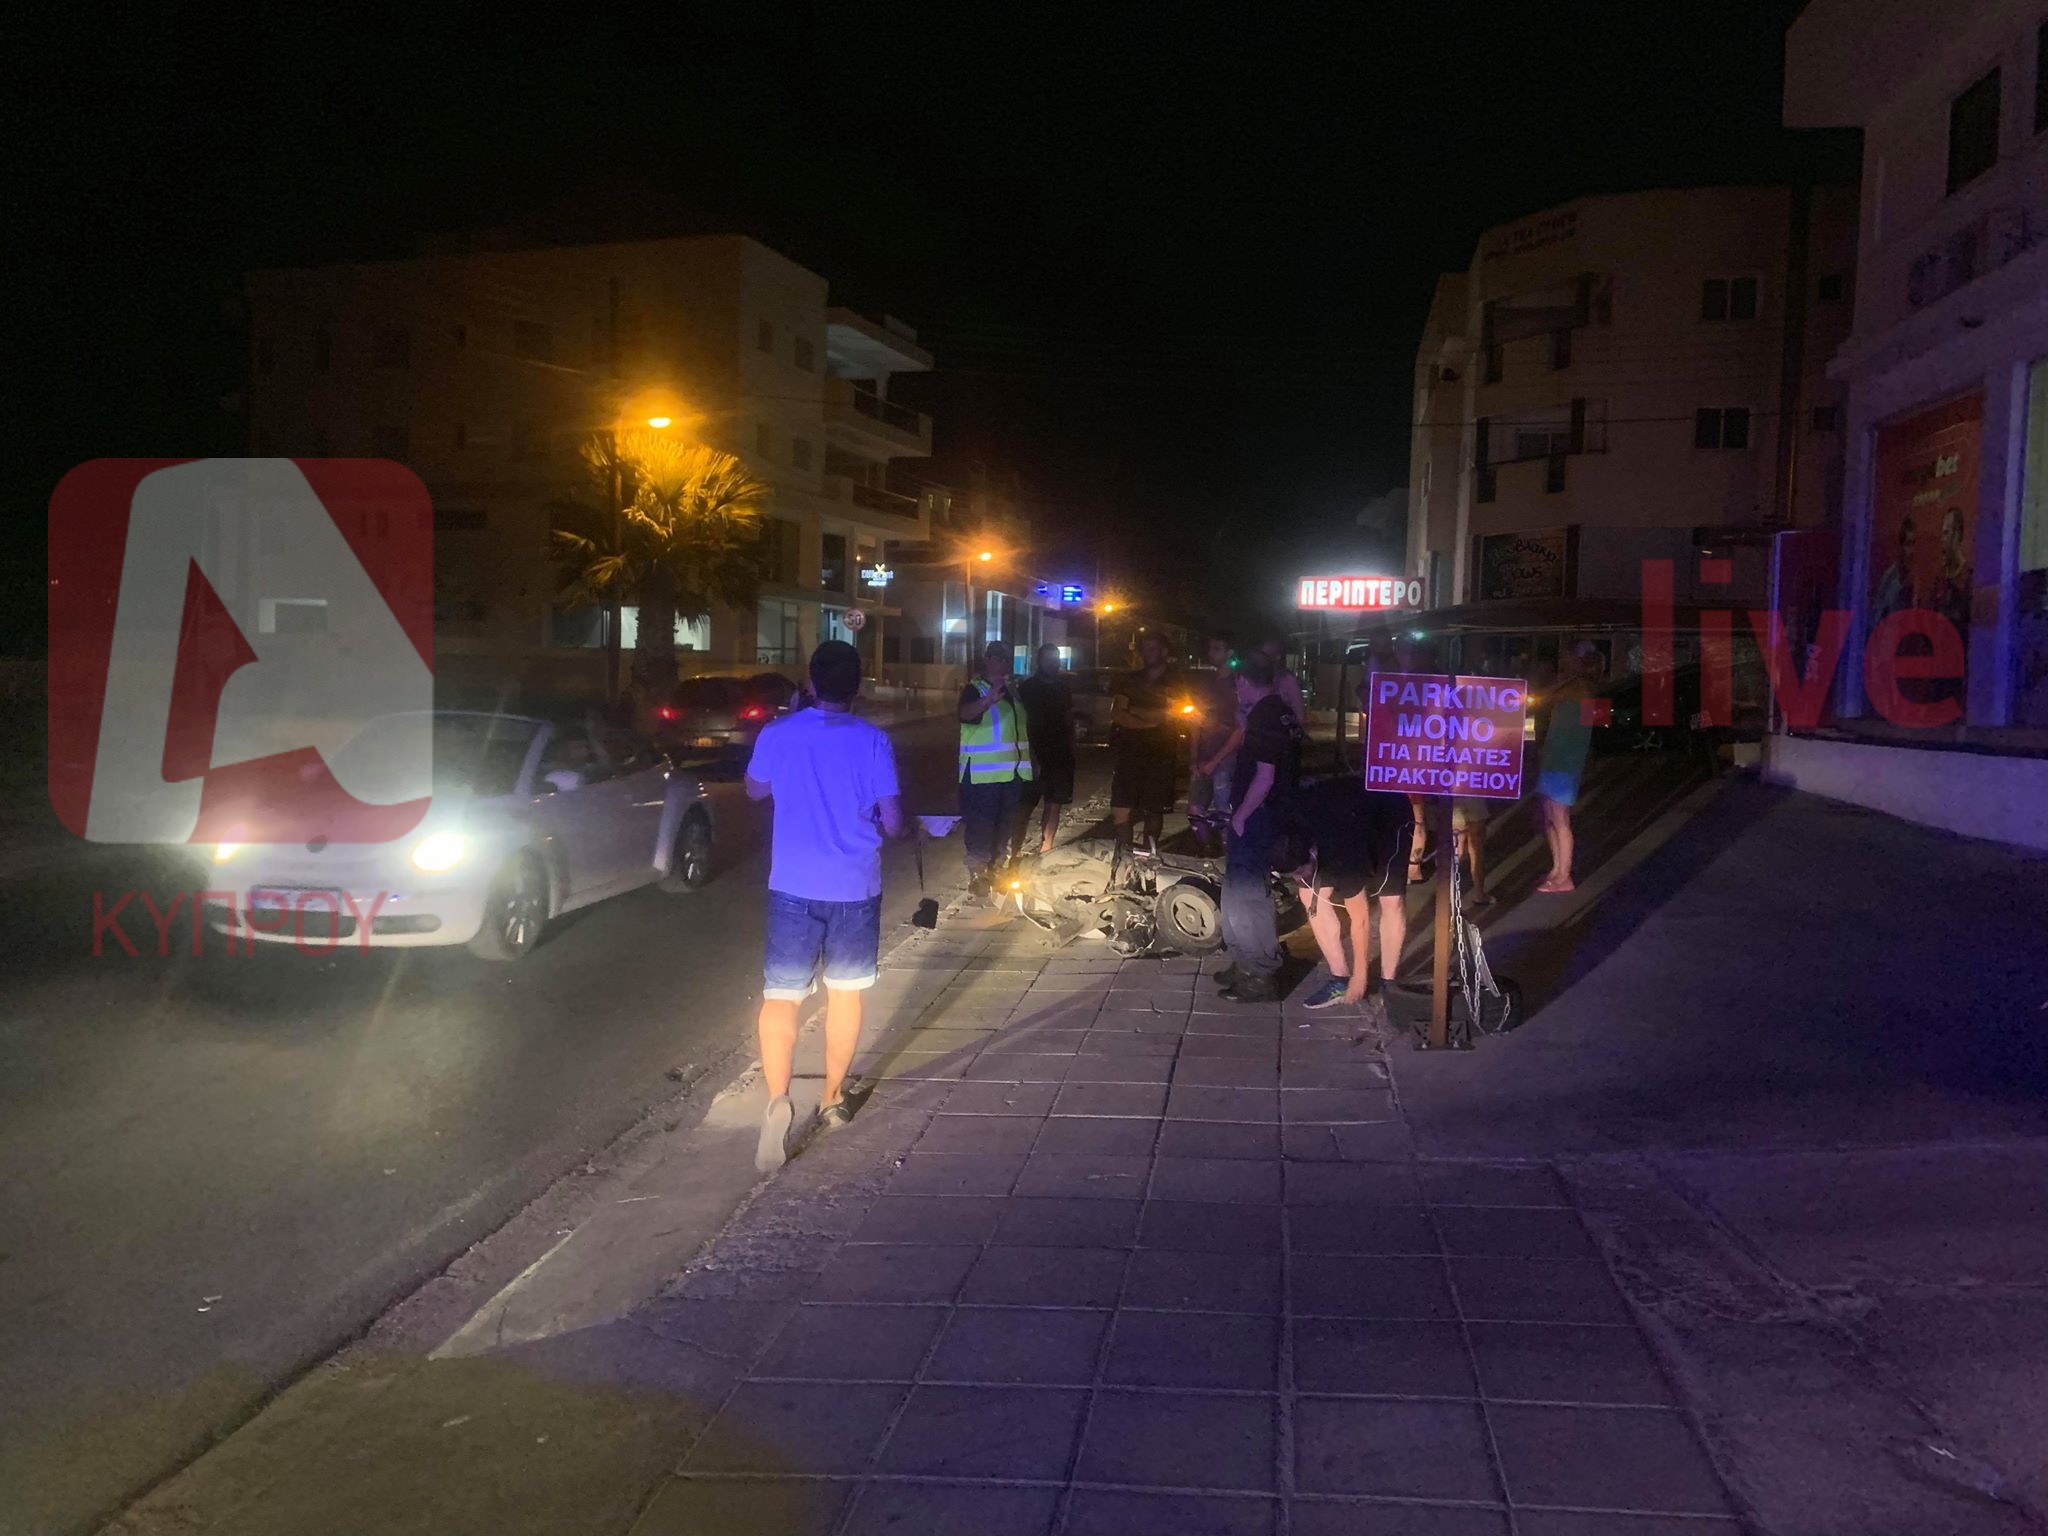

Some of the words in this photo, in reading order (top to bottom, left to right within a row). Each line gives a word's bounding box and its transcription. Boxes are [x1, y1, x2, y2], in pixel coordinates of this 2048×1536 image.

[1300, 580, 1421, 606] ΠΕΡΙΠΤΕΡΟ
[847, 613, 862, 626] 50
[1379, 680, 1521, 713] PARKING
[1397, 712, 1494, 742] ΜΟΝΟ
[1378, 742, 1410, 761] ΓΙΑ
[1417, 744, 1512, 767] ΠΕΛΑΤΕΣ
[1369, 765, 1519, 791] ΠΡΑΚΤΟΡΕΙΟΥ
